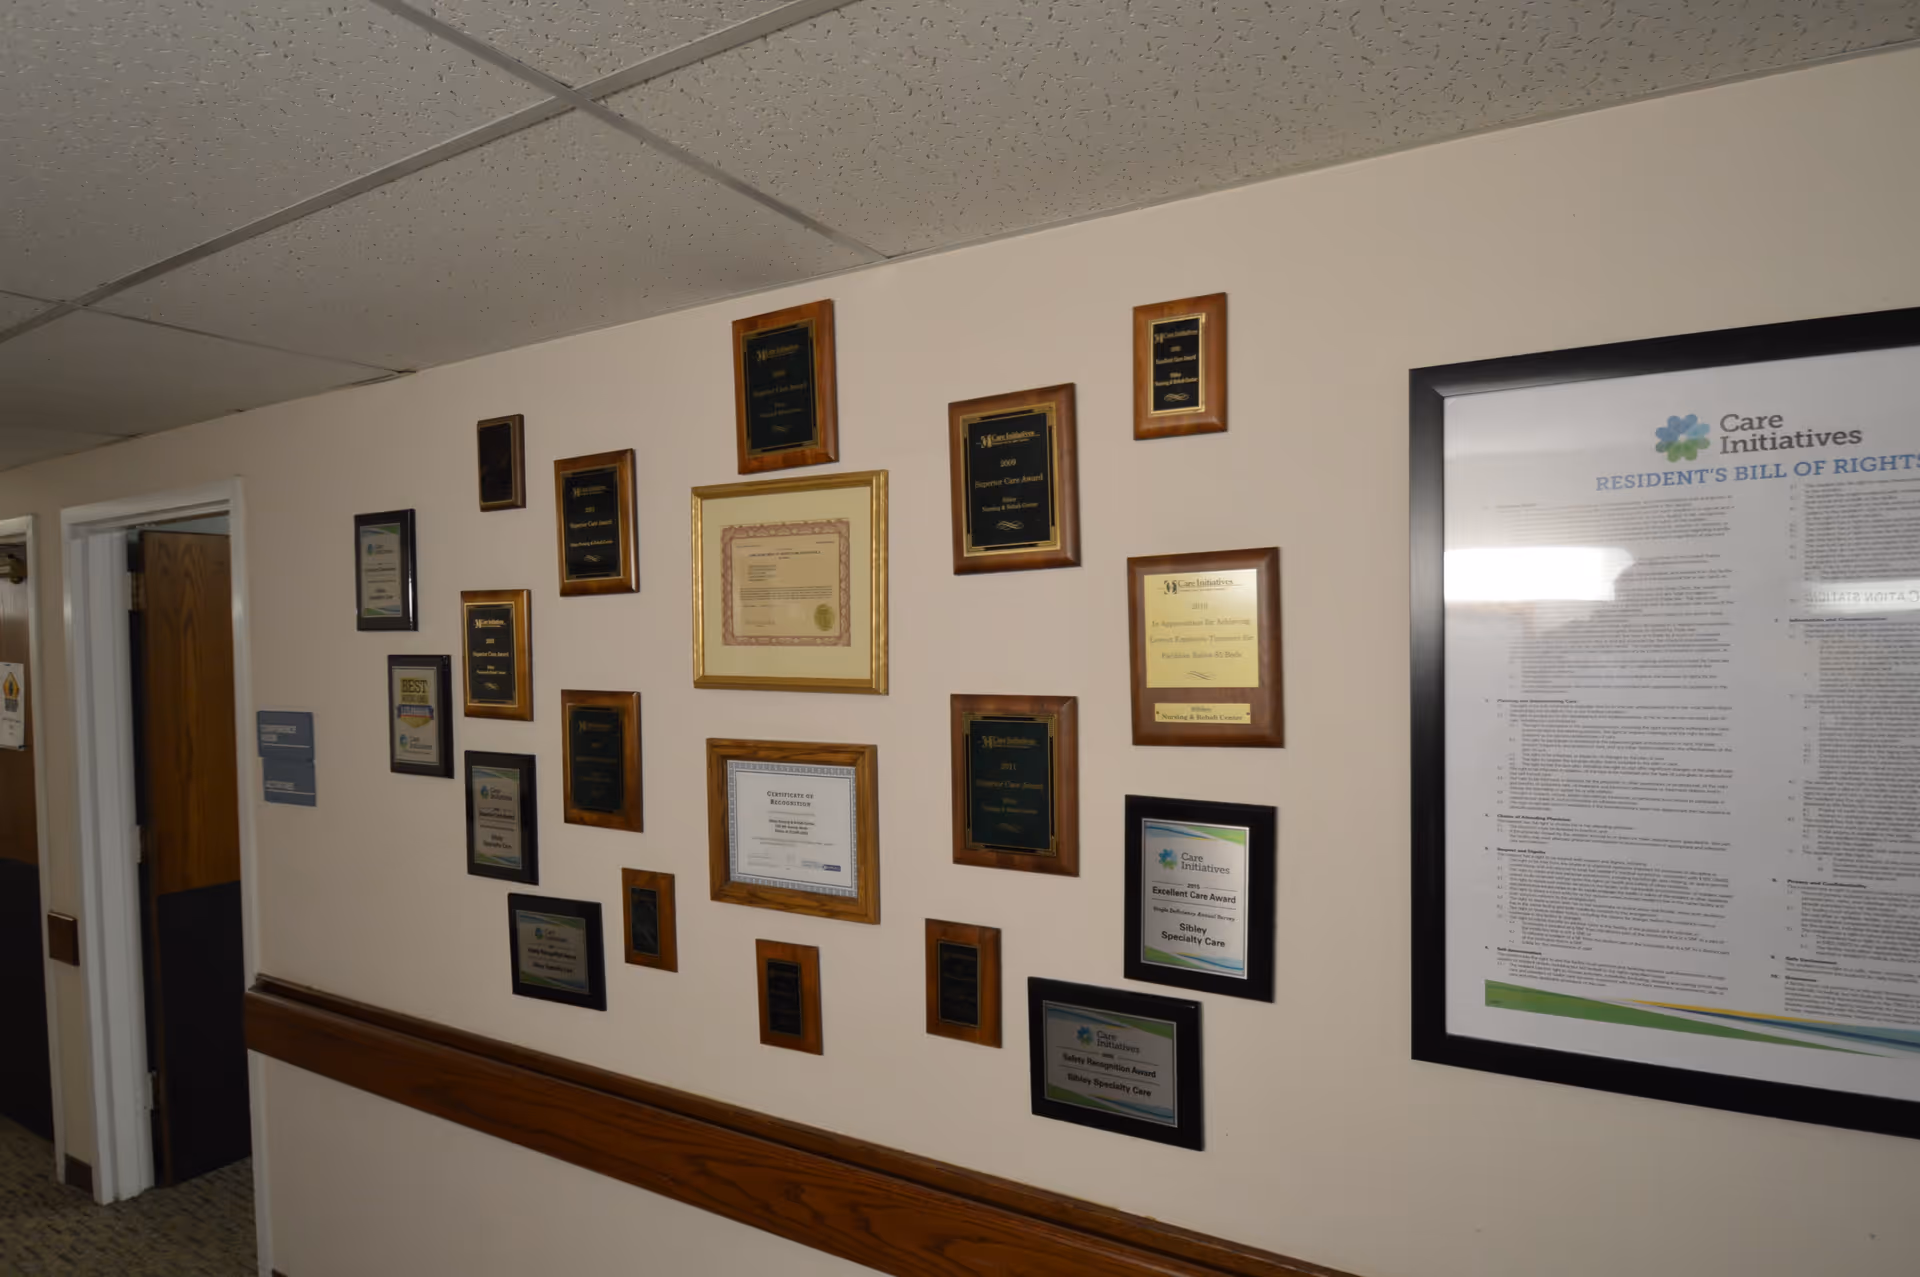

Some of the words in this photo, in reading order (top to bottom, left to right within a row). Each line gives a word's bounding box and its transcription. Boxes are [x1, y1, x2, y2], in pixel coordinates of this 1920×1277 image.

[1719, 413, 1783, 433] Care
[1719, 429, 1863, 454] Initiatives
[1735, 463, 1787, 481] BILL
[1793, 460, 1826, 477] OF
[1834, 453, 1920, 474] RIGHT
[1178, 580, 1196, 588] Care
[1197, 578, 1234, 586] Initiatives
[401, 679, 428, 694] BEST
[1161, 713, 1188, 722] Nursing
[1190, 713, 1195, 721] &
[1181, 852, 1204, 863] Care
[1181, 861, 1230, 875] Initiatives
[1152, 886, 1188, 898] Excellent
[1190, 891, 1208, 900] Care
[1209, 893, 1236, 904] Award
[1179, 923, 1207, 937] Sibley
[1161, 931, 1203, 946] Specialty
[1204, 937, 1226, 948] Care
[1097, 1030, 1118, 1041] Care
[1097, 1040, 1141, 1054] Initiatives
[1086, 1057, 1130, 1073] Recognition
[1131, 1067, 1157, 1078] Award
[1093, 1078, 1131, 1093] Specialty
[1132, 1086, 1153, 1098] Care
